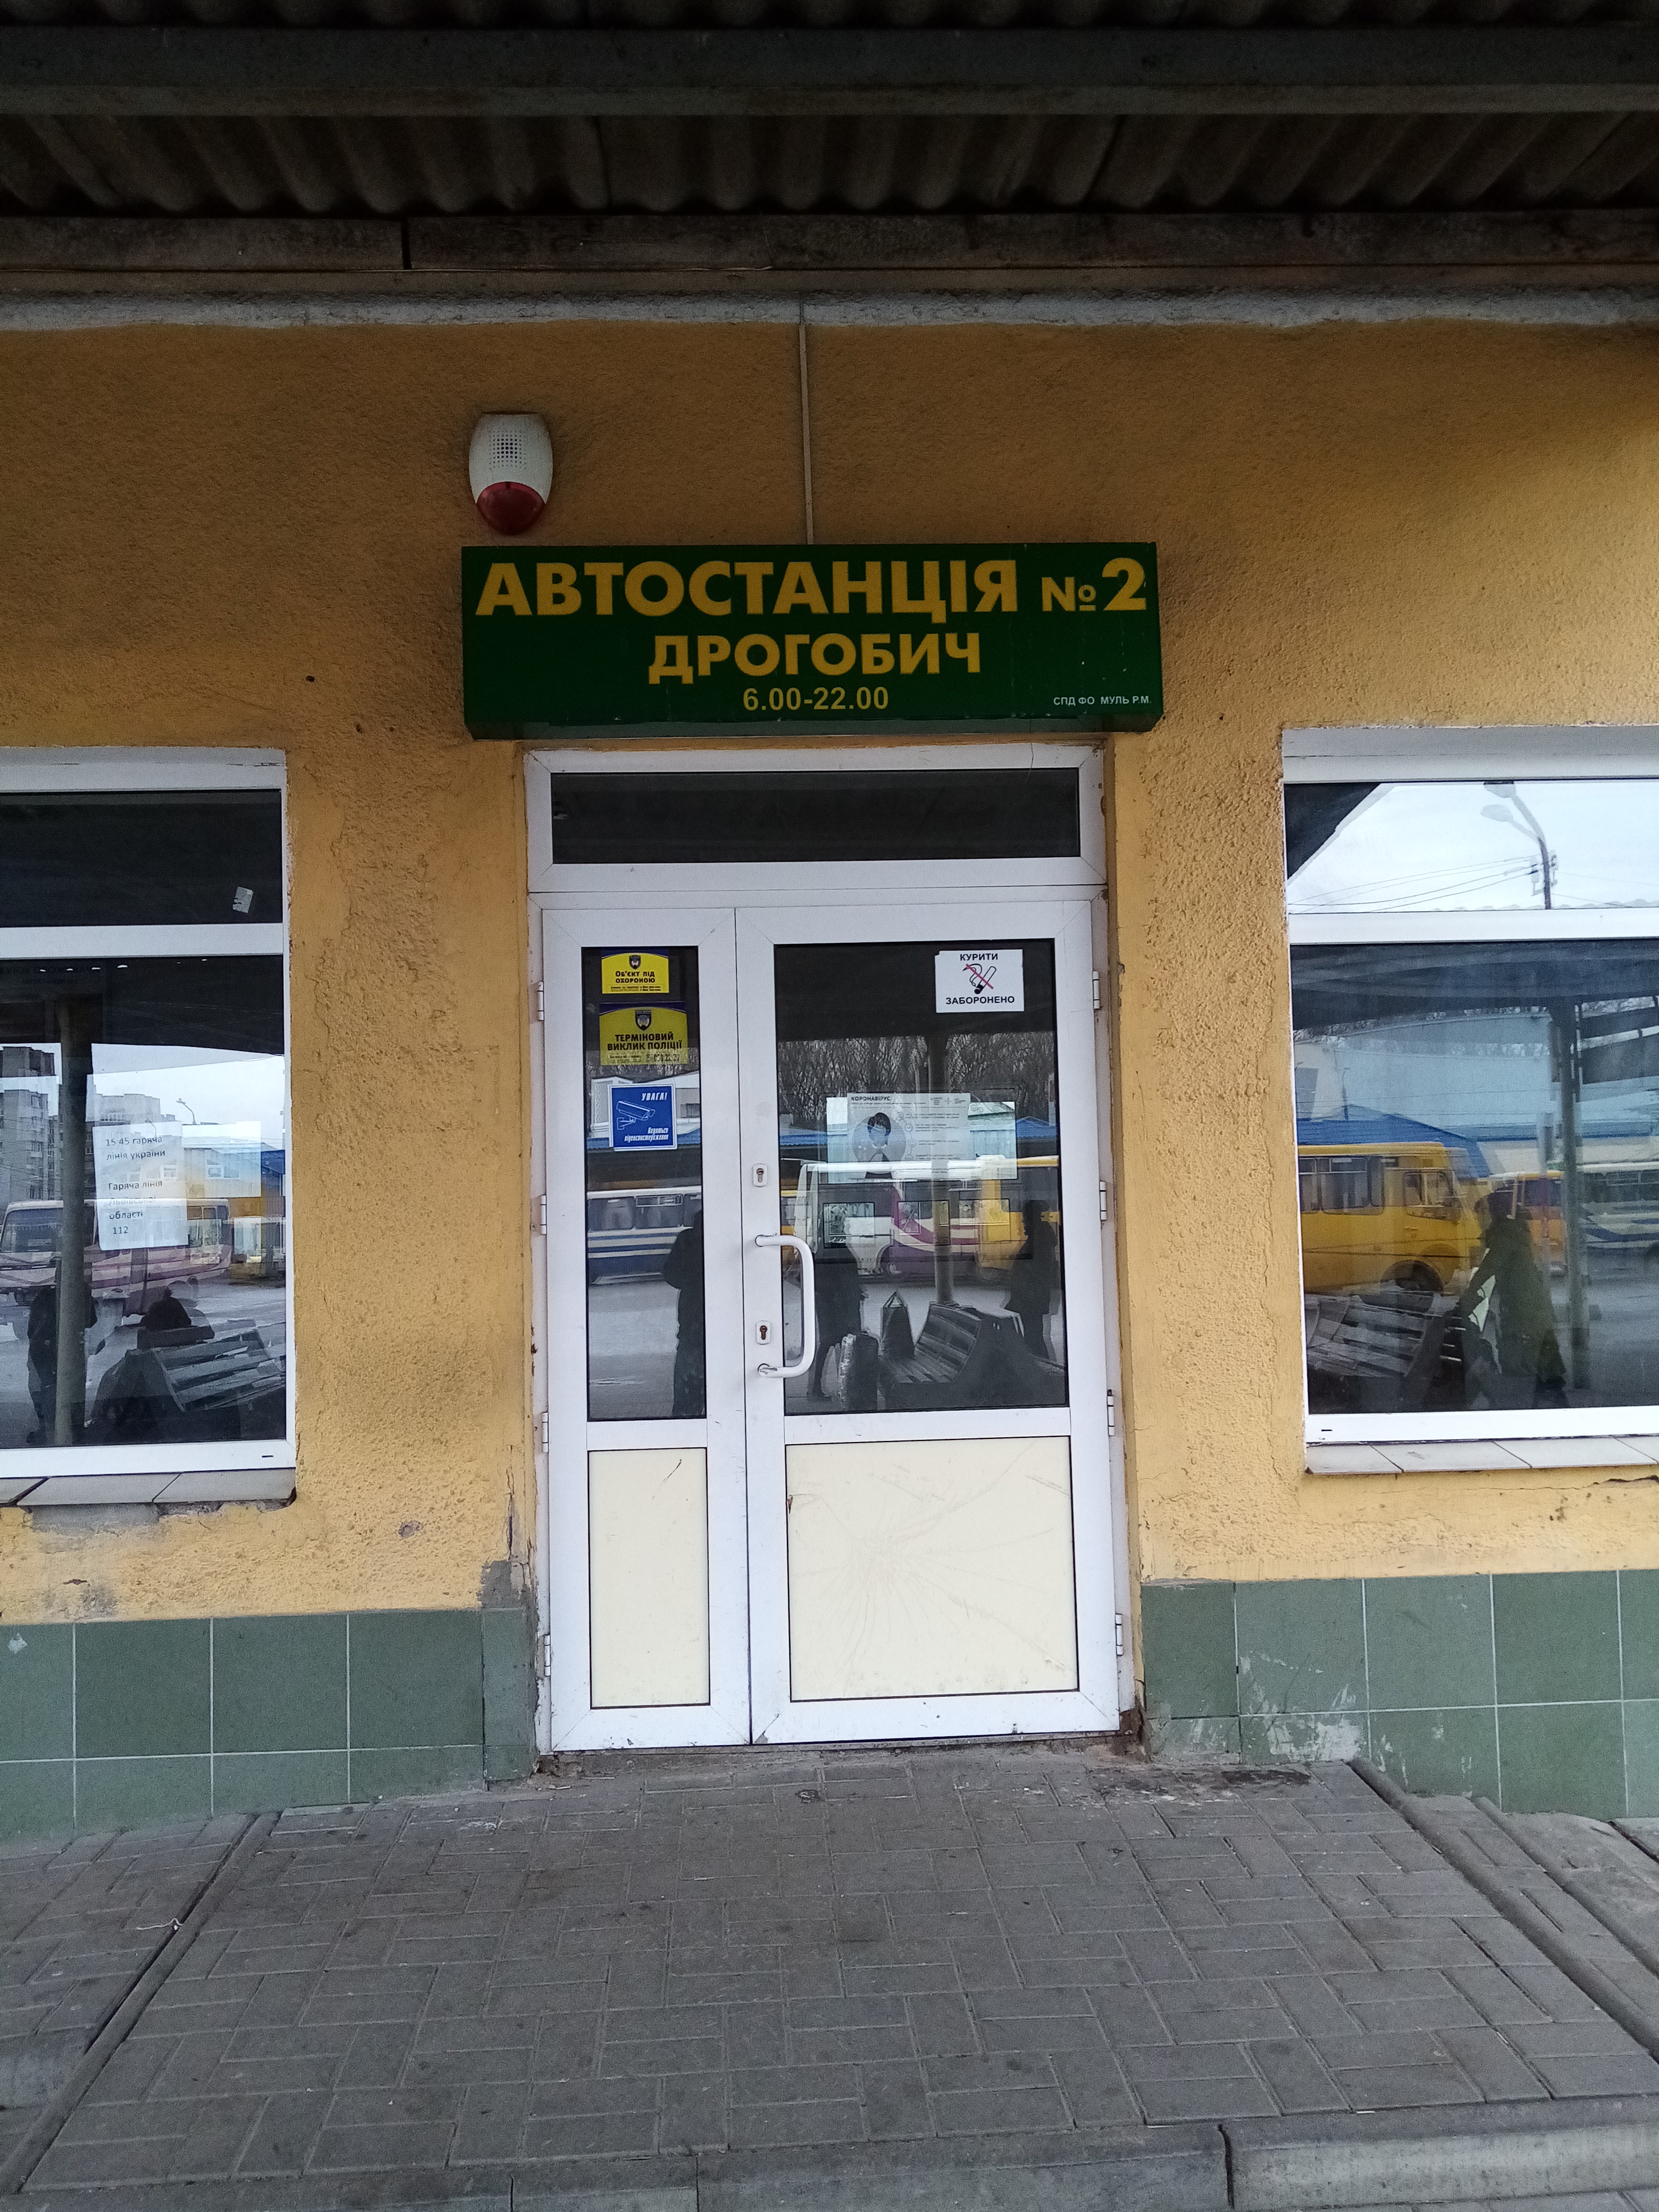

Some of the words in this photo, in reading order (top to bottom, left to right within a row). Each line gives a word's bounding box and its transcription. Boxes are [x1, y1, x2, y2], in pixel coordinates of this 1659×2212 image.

[475, 560, 1018, 624] АВТОСТАНЦІЯ
[648, 632, 981, 684] ДРОГОБИЧ
[742, 686, 889, 711] 6.00-22.00
[1053, 697, 1076, 706] СПД
[945, 996, 1015, 1004] ЗАБОРОНЕНО
[615, 1032, 674, 1042] ТЕРМІНОВИЙ
[648, 1040, 682, 1050] ПОЛІЦІЇ
[641, 1092, 668, 1101] УВАГА!
[132, 1137, 162, 1145] гаряча
[106, 1151, 128, 1160] лінія
[131, 1150, 165, 1160] україни
[108, 1181, 139, 1191] Гаряча
[141, 1180, 163, 1189] лінія
[109, 1211, 143, 1220] області
[113, 1226, 129, 1235] 112
